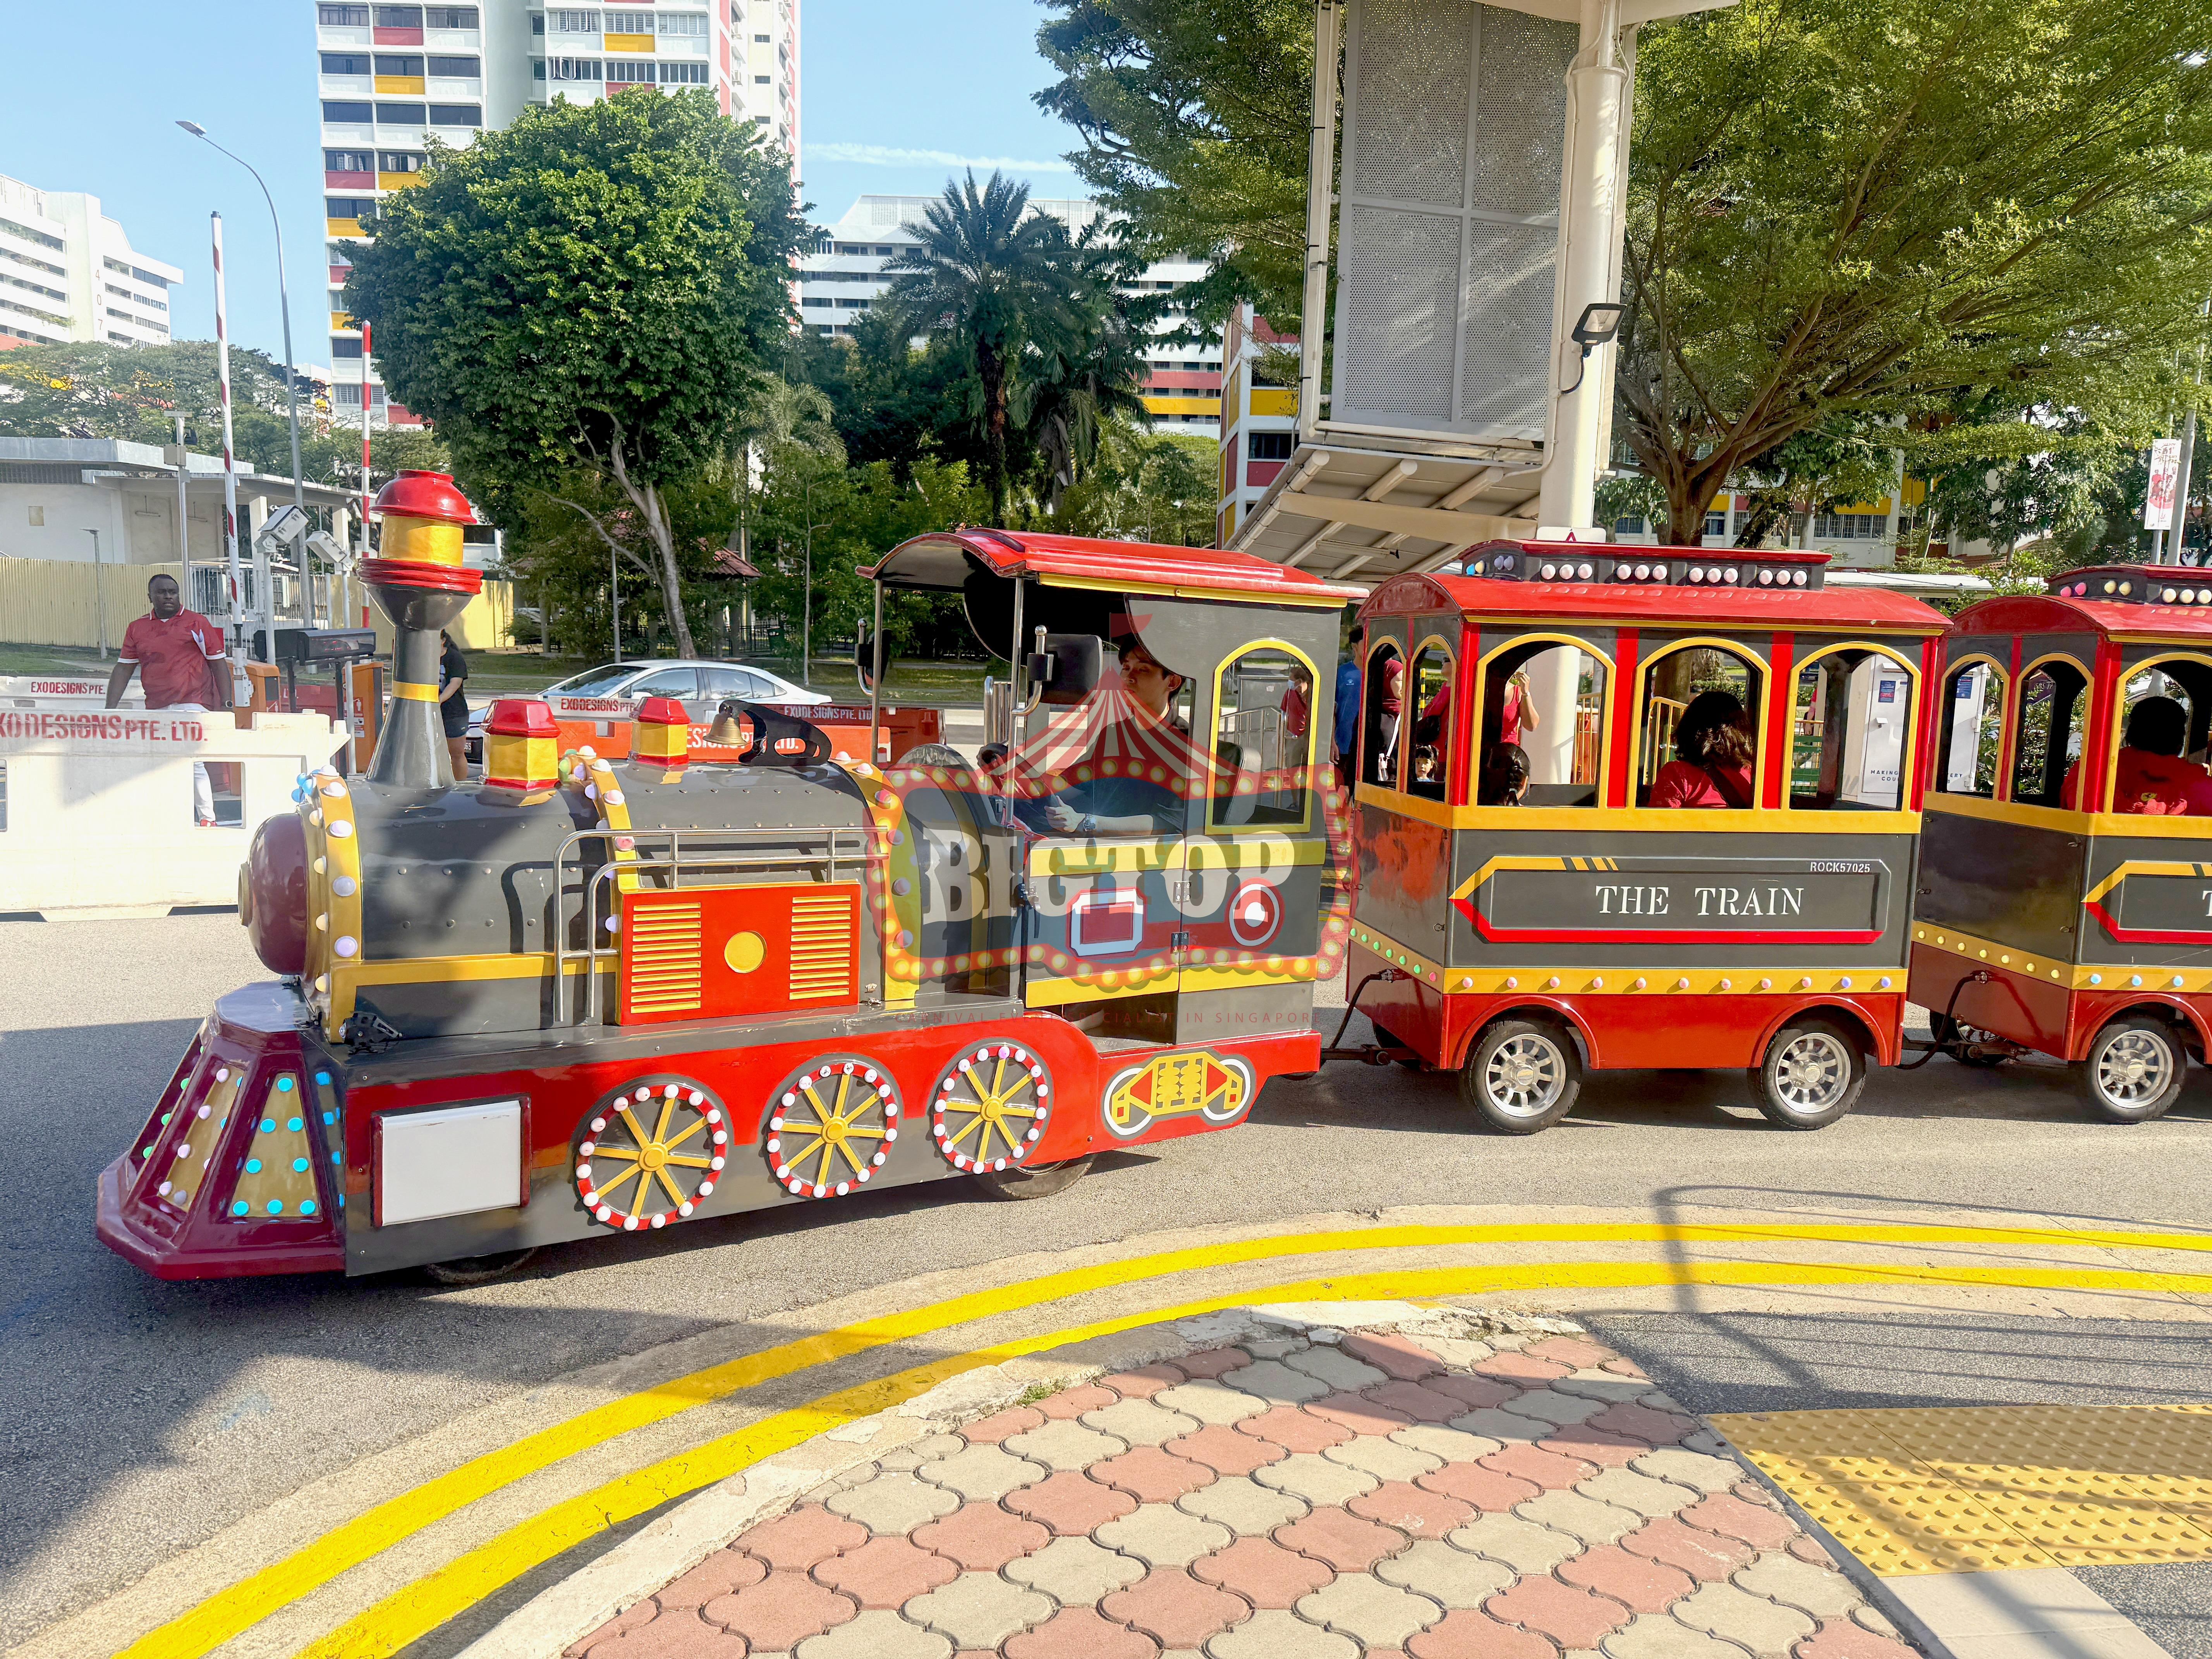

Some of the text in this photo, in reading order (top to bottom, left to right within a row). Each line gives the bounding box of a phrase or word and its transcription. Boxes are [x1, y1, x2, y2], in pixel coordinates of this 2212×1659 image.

[31, 682, 105, 694] EXODESIGNS PTE.
[561, 698, 618, 711] EXODESIGNS
[840, 709, 857, 719] PTE.
[125, 720, 166, 740] PTE.
[172, 721, 208, 741] LTD.
[1810, 862, 1870, 873] ROCK57025
[1596, 886, 1804, 916] THE TRAIN
